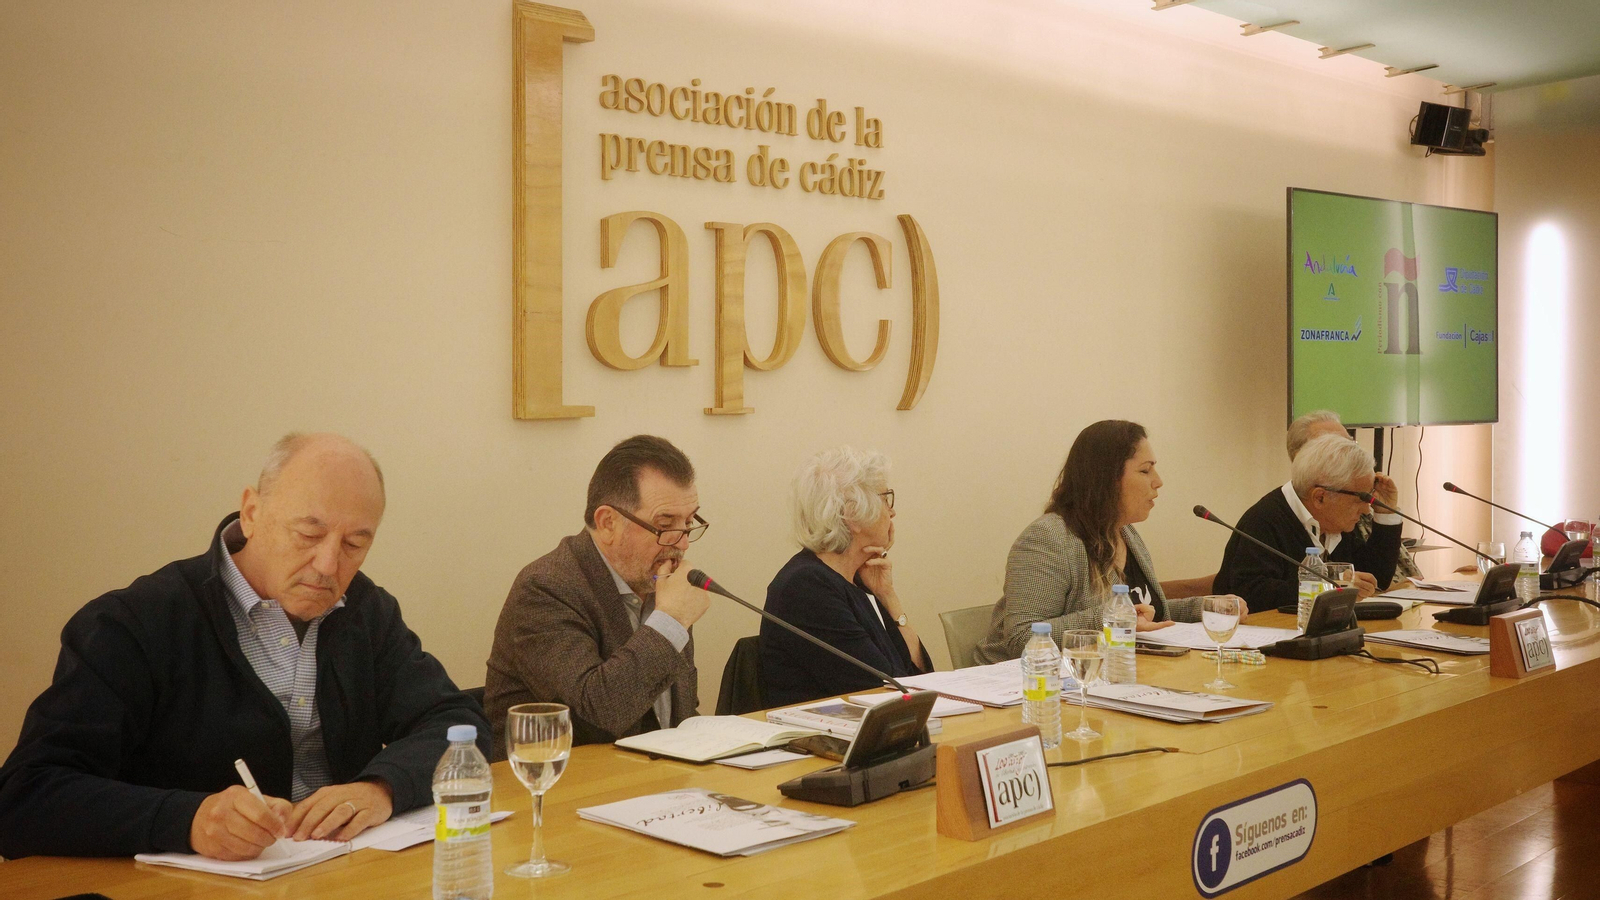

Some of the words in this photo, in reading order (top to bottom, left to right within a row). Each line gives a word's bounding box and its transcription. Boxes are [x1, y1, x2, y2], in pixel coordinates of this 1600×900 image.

[599, 73, 798, 136] asociación
[806, 98, 846, 143] de
[854, 106, 884, 148] la
[599, 132, 737, 181] prensa
[747, 144, 790, 189] de
[799, 152, 886, 200] cádiz
[1300, 329, 1350, 341] ZONAFRANCA
[1235, 813, 1287, 849] Síguenos
[1292, 806, 1308, 824] en:
[1235, 826, 1306, 861] facebook.com/prensacadiz
